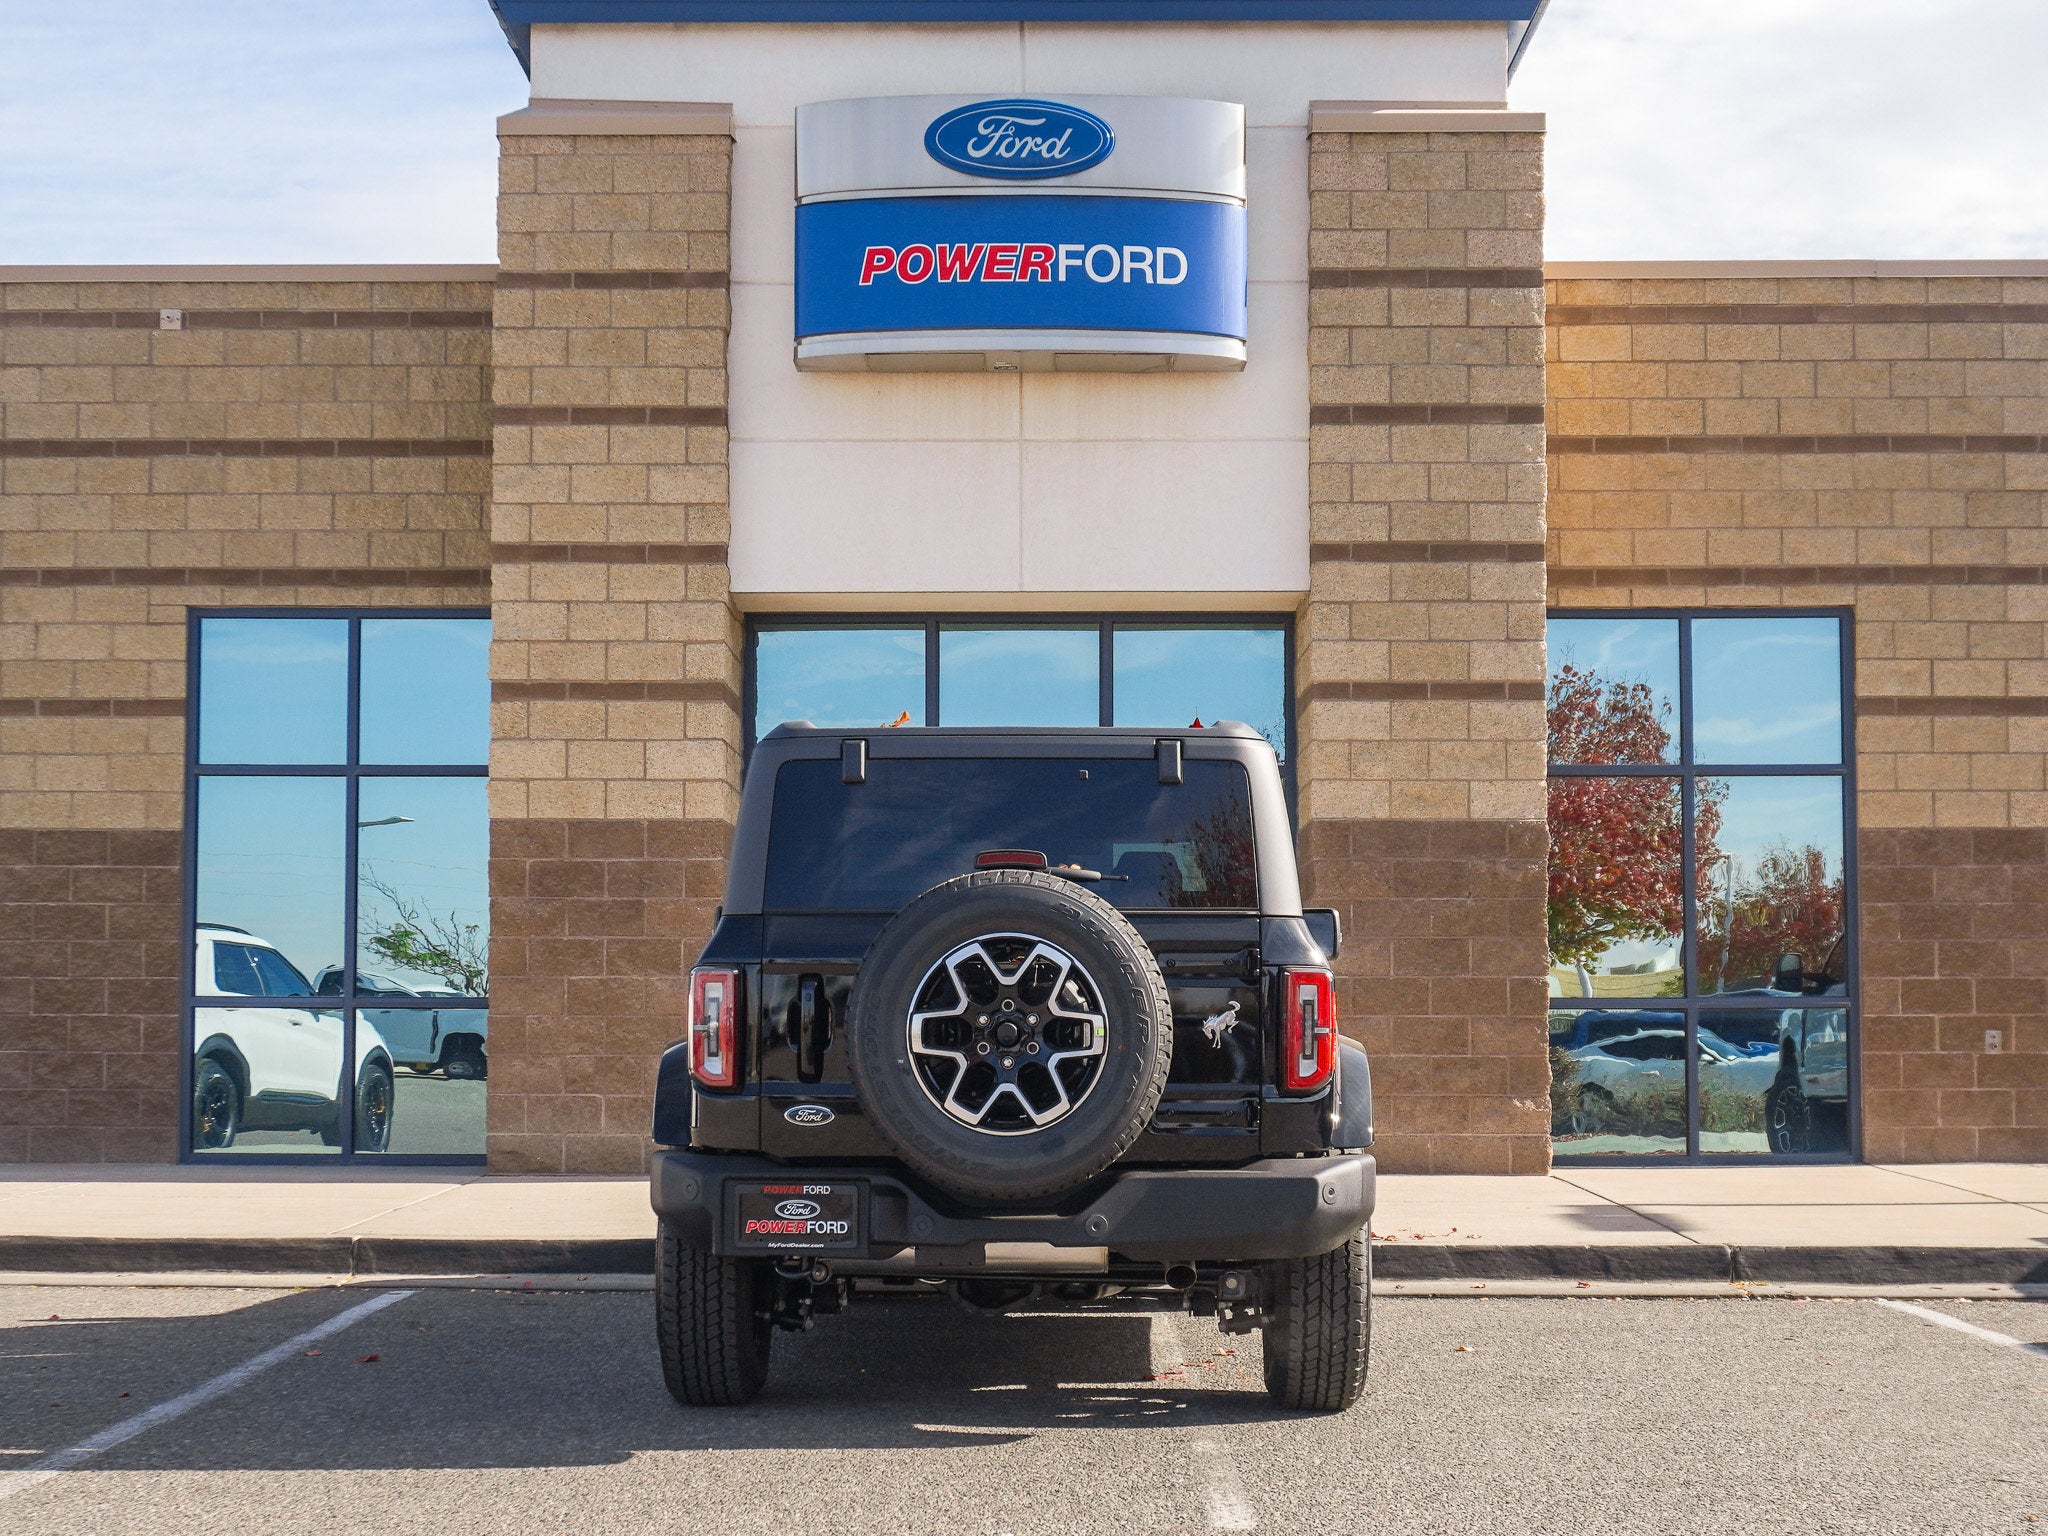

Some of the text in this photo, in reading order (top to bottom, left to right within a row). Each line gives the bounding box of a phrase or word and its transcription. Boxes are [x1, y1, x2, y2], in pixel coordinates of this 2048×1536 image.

[966, 115, 1072, 159] Ford
[859, 242, 1188, 286] POWERFORD
[795, 1109, 823, 1121] Ford
[763, 1185, 831, 1195] POWERFORD
[783, 1203, 811, 1216] Ford
[745, 1219, 848, 1234] POWERFORD
